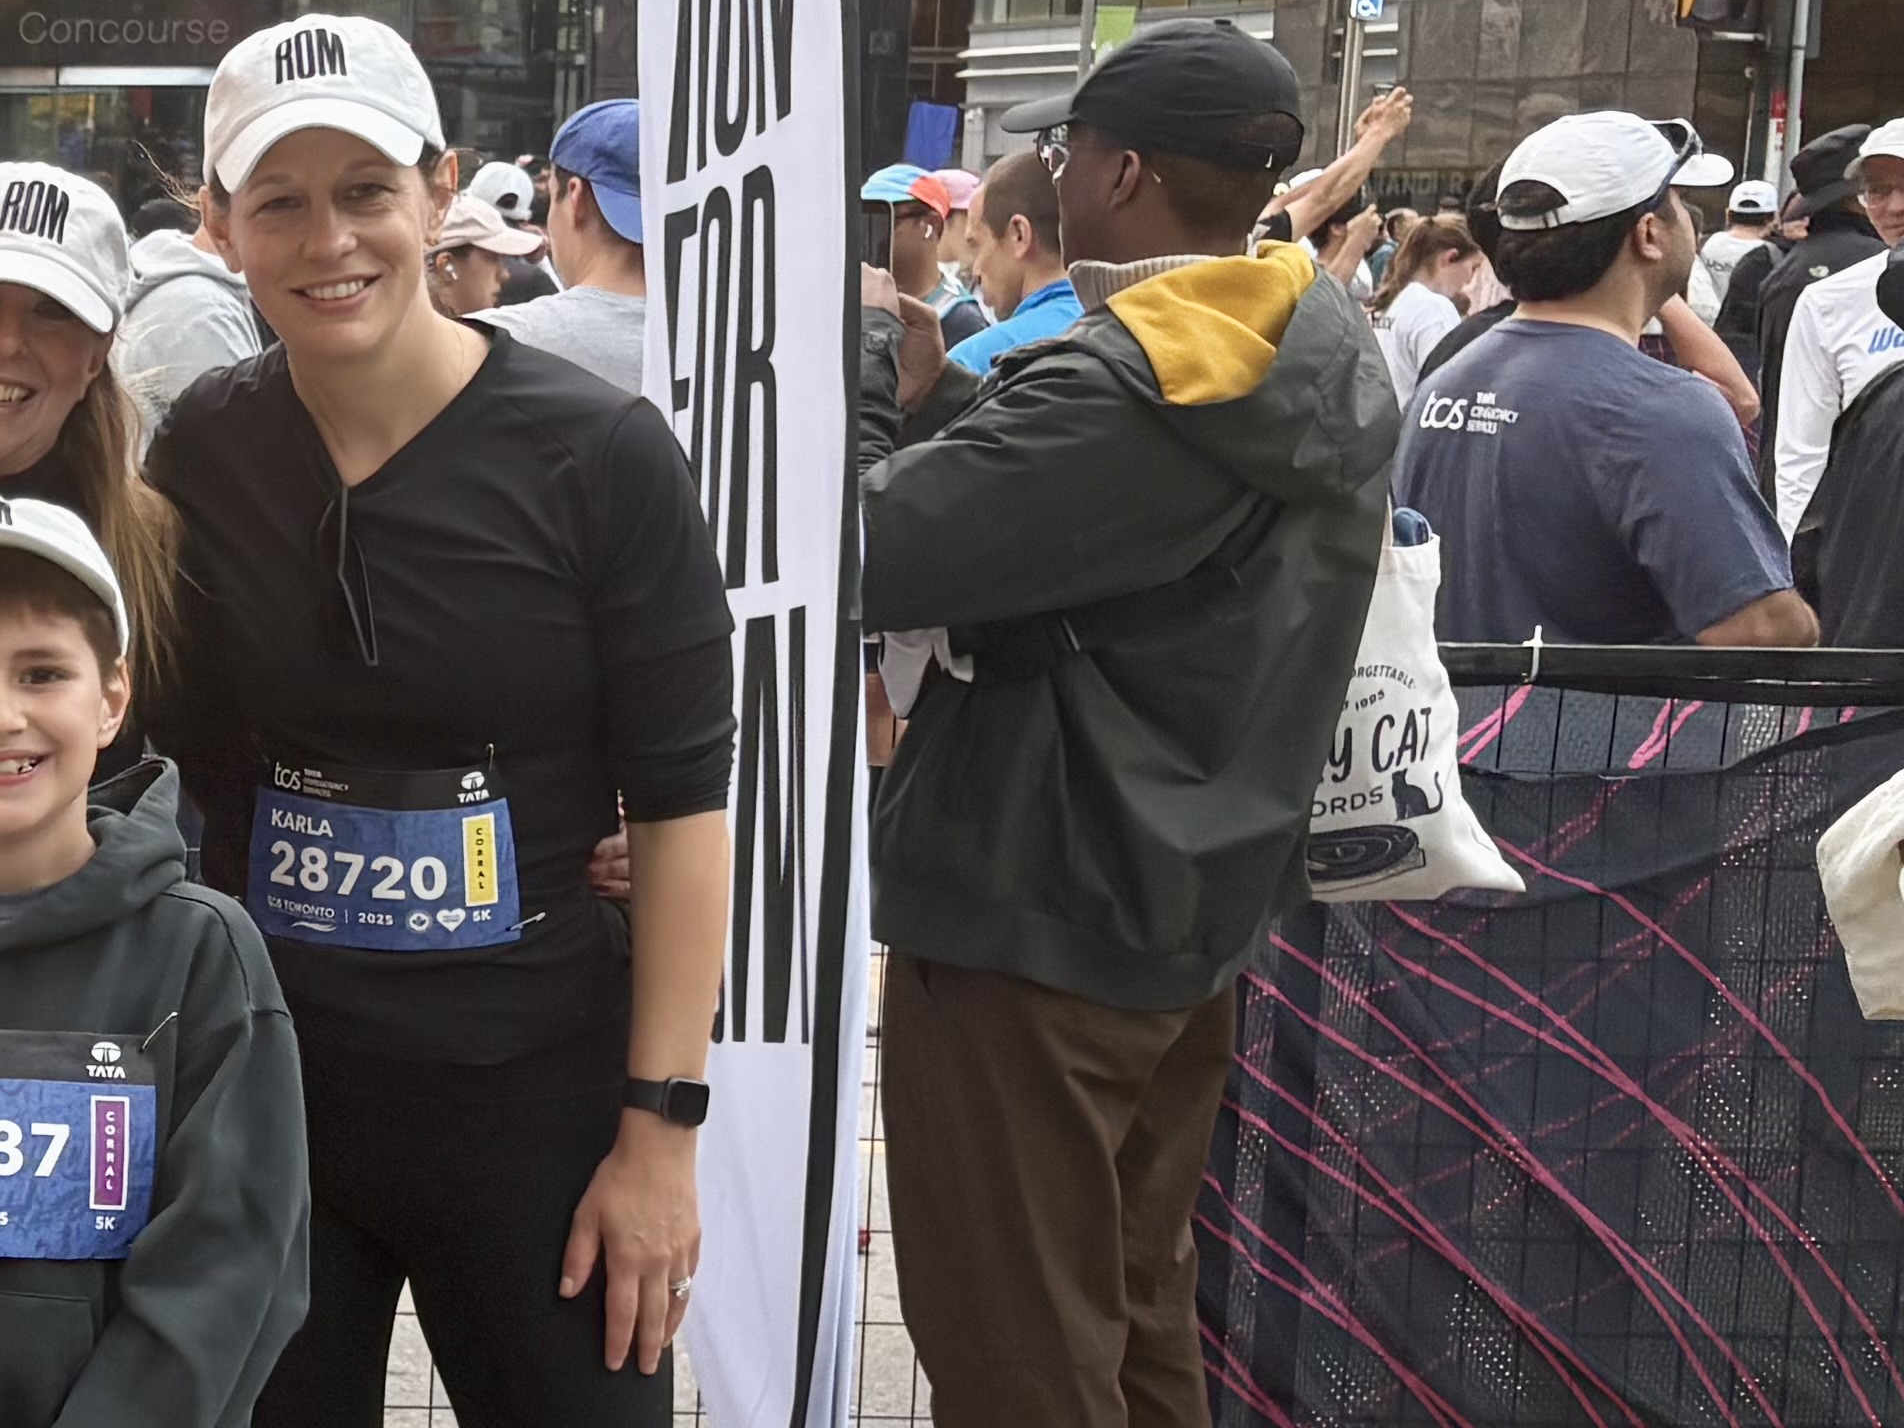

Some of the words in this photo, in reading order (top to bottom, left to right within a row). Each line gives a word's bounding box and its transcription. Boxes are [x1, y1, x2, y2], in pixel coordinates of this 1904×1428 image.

[19, 11, 230, 46] Concourse
[275, 28, 348, 85] ROM
[662, 162, 780, 589] FOR
[1419, 390, 1469, 431] tcs
[1371, 706, 1432, 774] CAT
[274, 761, 302, 792] tcs
[456, 788, 491, 804] TATA
[271, 808, 334, 838] KARLA
[269, 839, 448, 901] 28720
[475, 827, 485, 890] CORRAL
[283, 901, 336, 919] TORONTO
[358, 911, 394, 926] 2025
[472, 909, 492, 923] 5K
[86, 1064, 127, 1079] TATA
[104, 1110, 116, 1191] CORRAL
[95, 1215, 116, 1231] 5K
